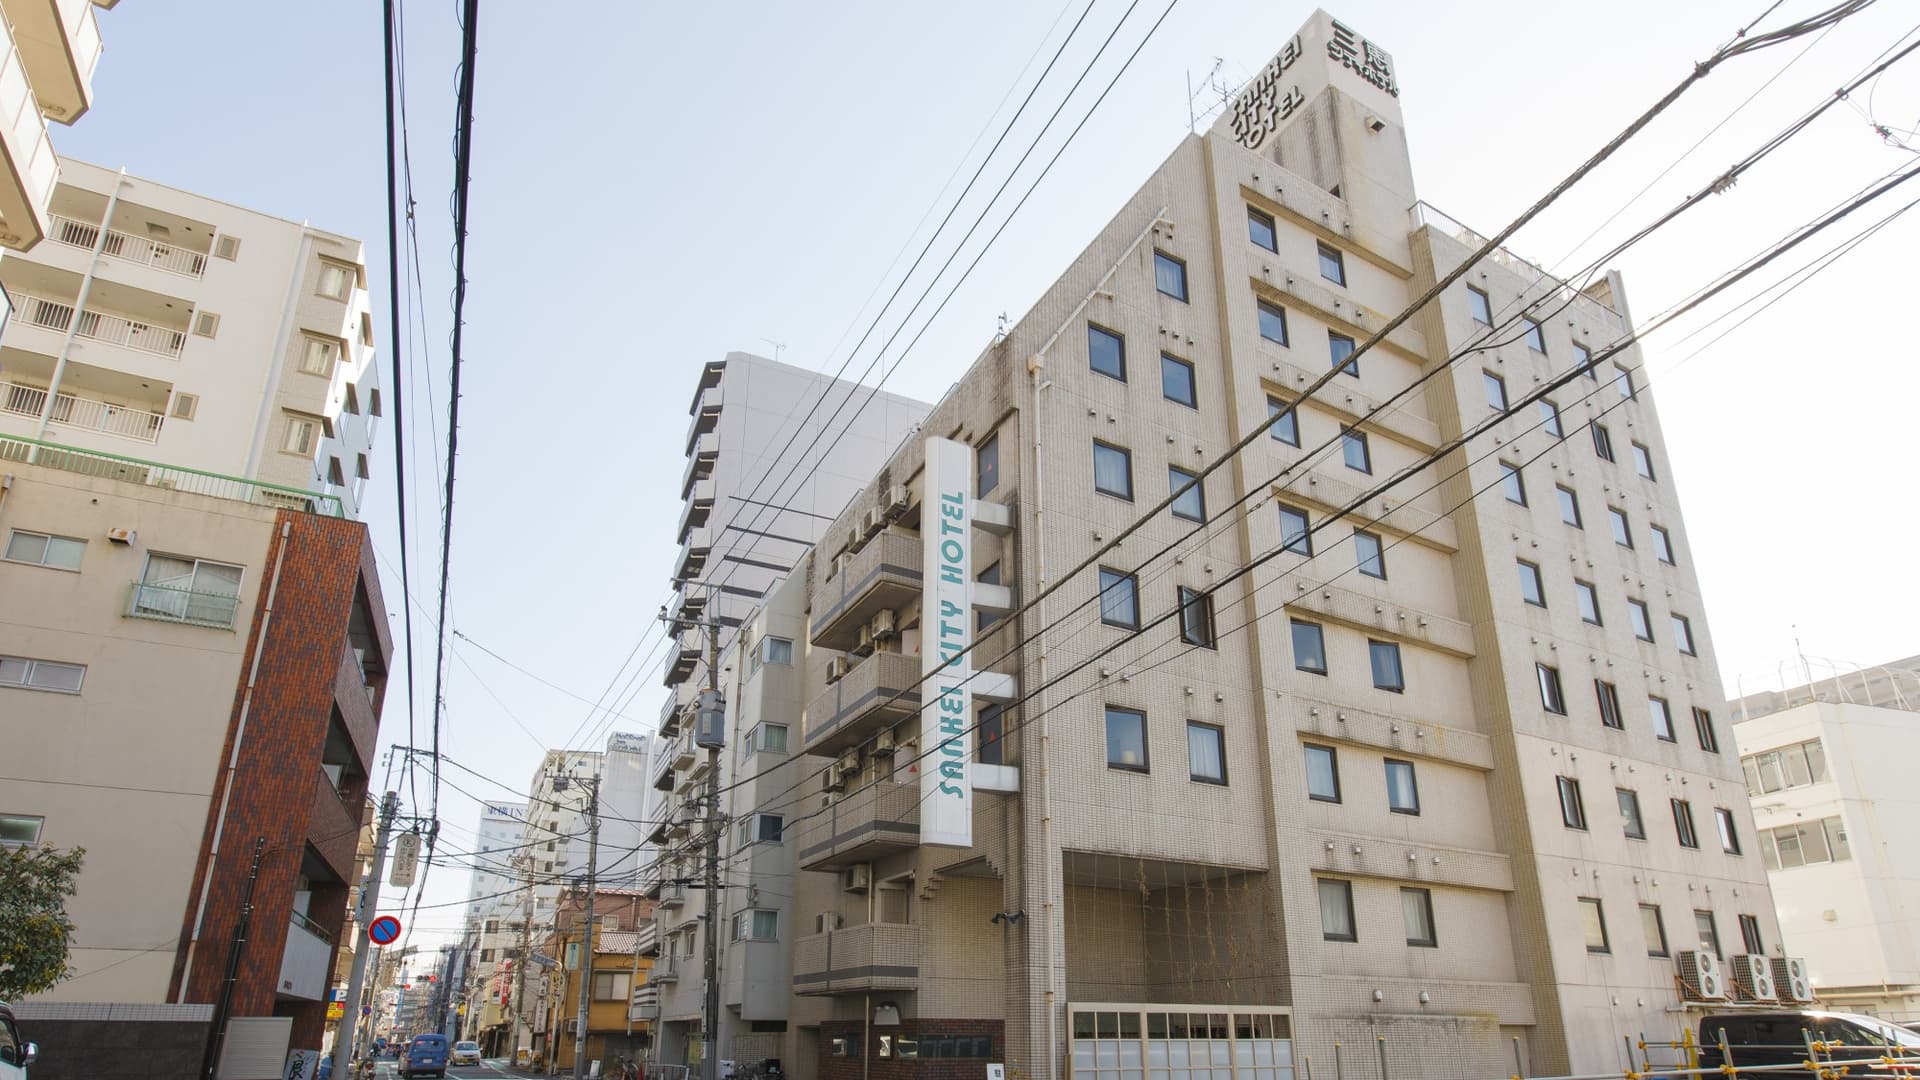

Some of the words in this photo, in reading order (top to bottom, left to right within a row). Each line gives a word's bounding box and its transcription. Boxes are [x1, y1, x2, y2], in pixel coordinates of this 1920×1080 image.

[1230, 34, 1303, 127] SANKEI
[1232, 84, 1277, 143] CITY
[1239, 85, 1305, 150] OTEL
[940, 492, 964, 584] HOTEL
[940, 600, 964, 677] CITY
[939, 687, 964, 799] SANKEI
